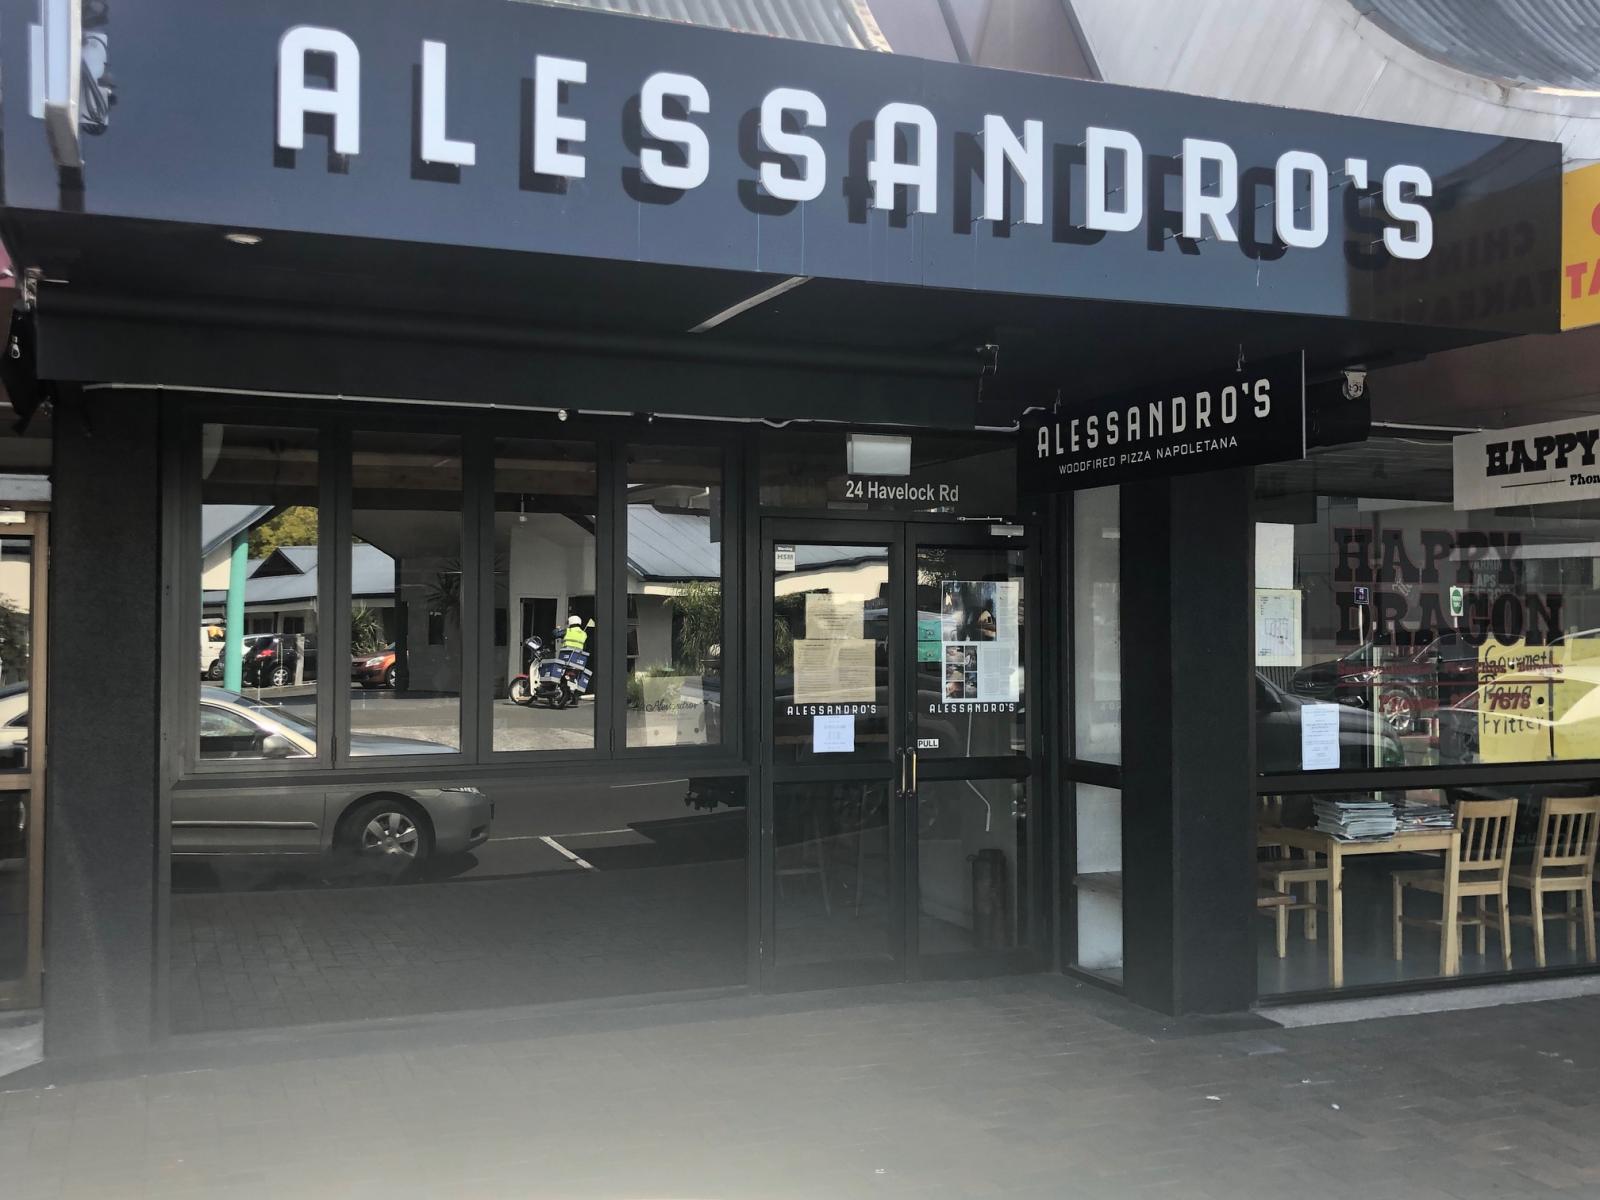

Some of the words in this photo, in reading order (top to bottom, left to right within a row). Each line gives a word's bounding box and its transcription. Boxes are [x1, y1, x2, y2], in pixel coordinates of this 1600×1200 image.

[277, 25, 1434, 260] ALESSANDRO'S
[1037, 378, 1271, 458] ALESSANDRO'S
[1058, 456, 1116, 475] WOODFIRED
[1120, 451, 1152, 465] PIZZA
[1156, 435, 1238, 459] NAPOLETANA
[1486, 428, 1600, 477] HAPPY
[845, 480, 863, 498] 24
[868, 481, 935, 501] Havelock
[940, 484, 959, 501] Rd
[1333, 527, 1522, 583] HAPPY
[1335, 591, 1566, 648] DRAGON
[1485, 645, 1547, 668] Gourmet
[787, 704, 876, 716] ALESSANDRO'S
[929, 703, 1015, 714] ALESSANDRO'S
[1488, 692, 1531, 711] 7678
[918, 740, 939, 748] PULL
